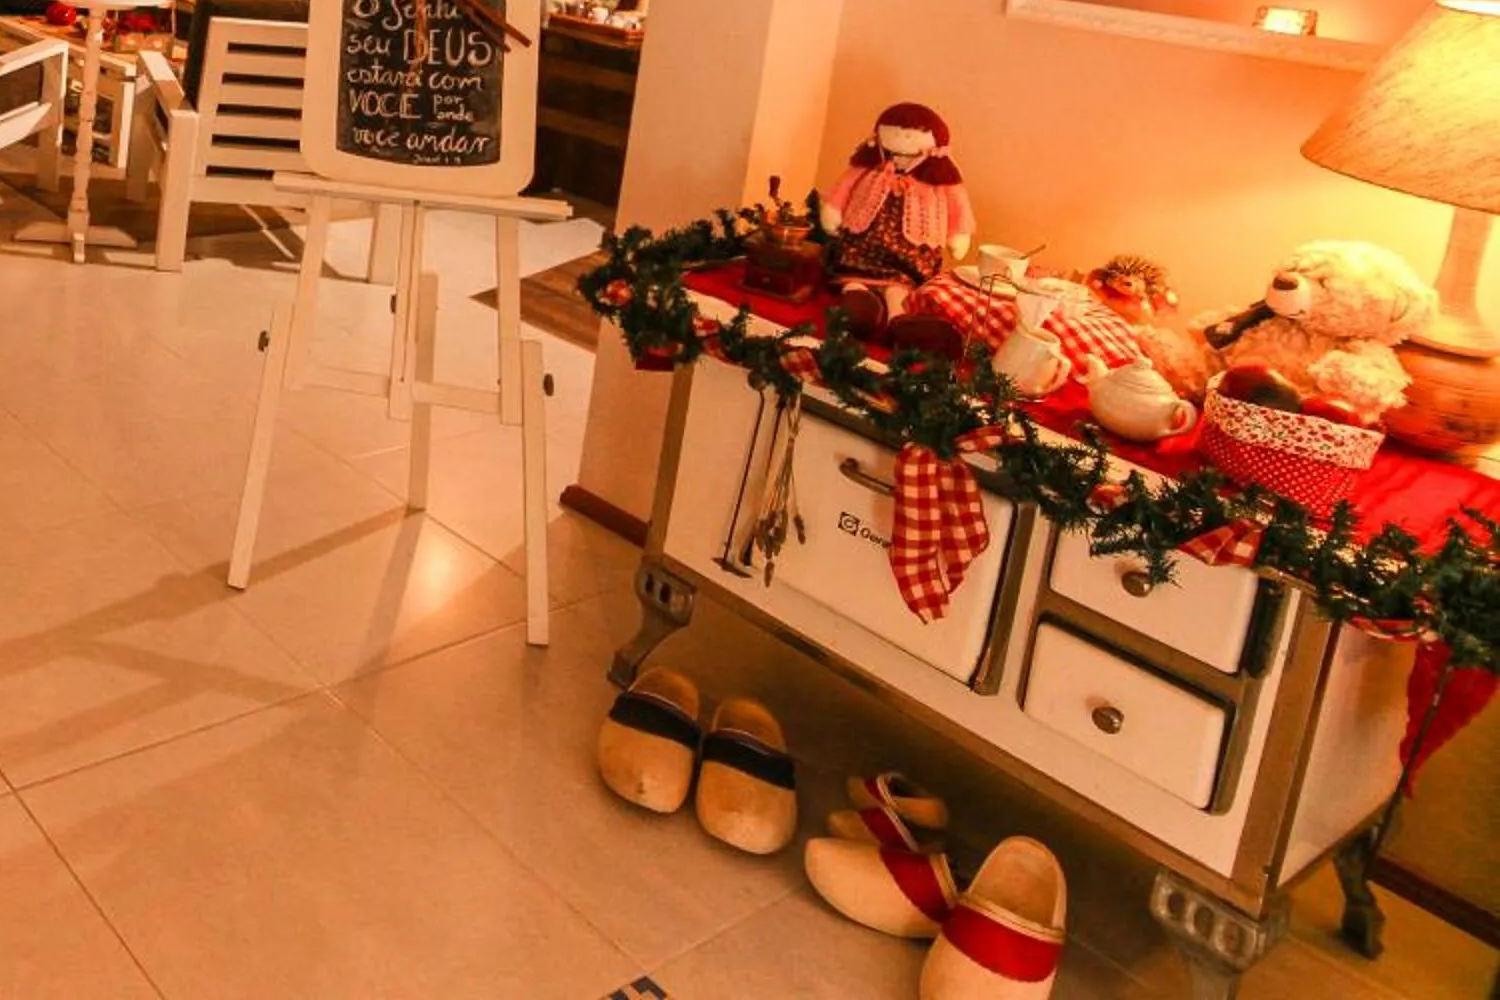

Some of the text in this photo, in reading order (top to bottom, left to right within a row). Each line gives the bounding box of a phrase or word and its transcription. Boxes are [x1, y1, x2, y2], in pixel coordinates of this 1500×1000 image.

[347, 28, 492, 67] seu DEUS
[429, 71, 483, 91] com
[406, 128, 490, 153] andar
